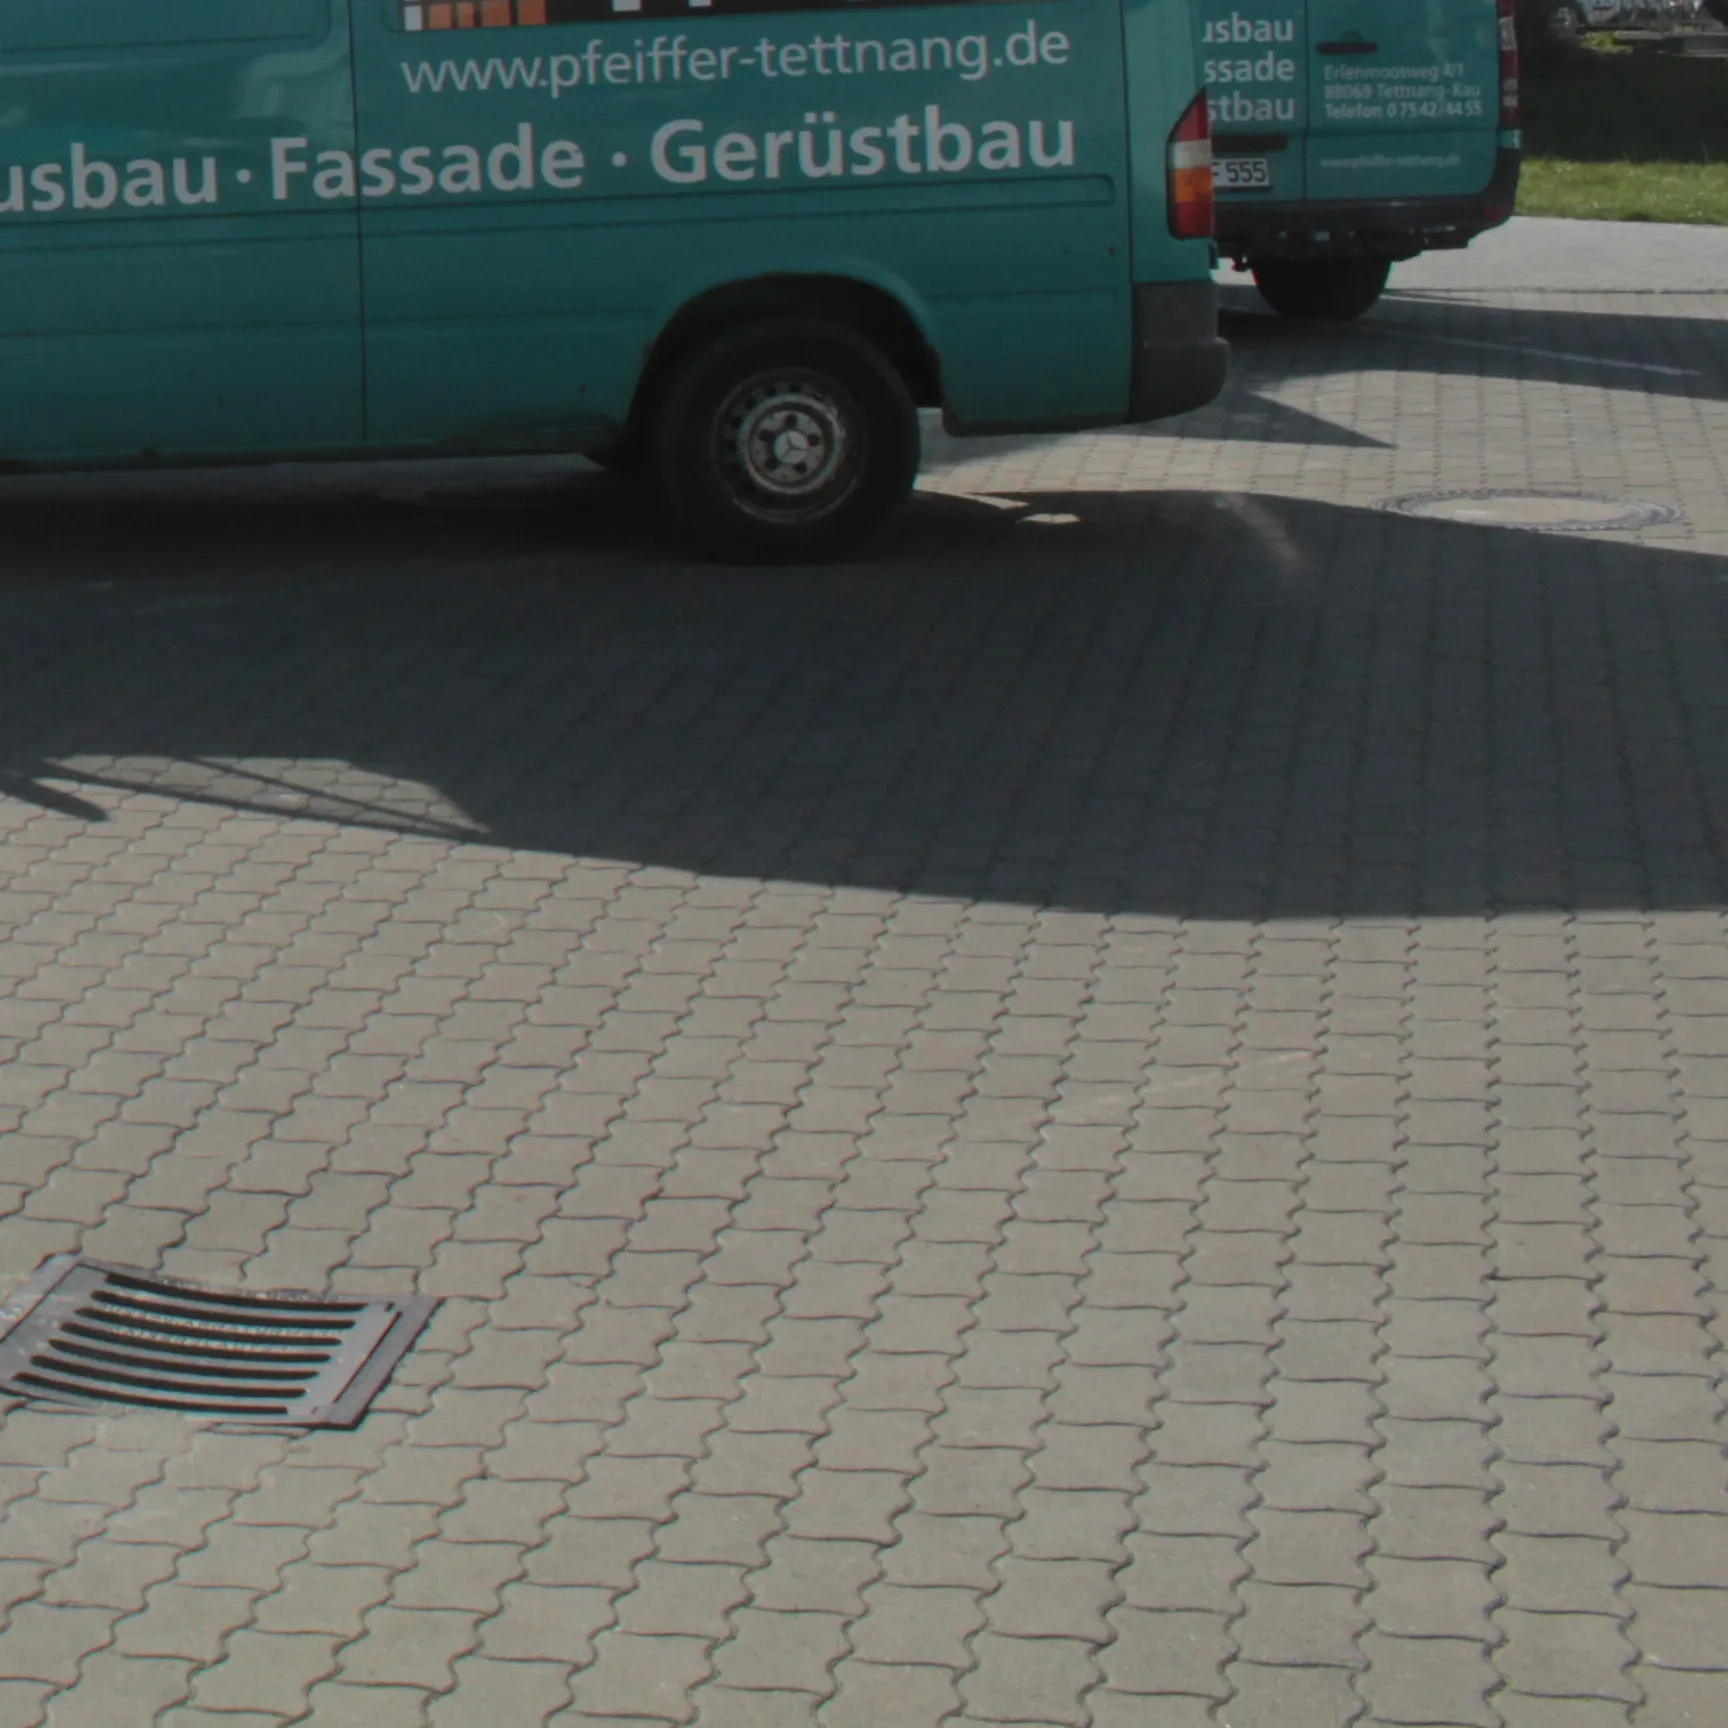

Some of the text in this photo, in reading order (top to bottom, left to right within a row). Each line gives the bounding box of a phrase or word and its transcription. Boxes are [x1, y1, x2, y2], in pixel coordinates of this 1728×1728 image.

[401, 19, 1071, 98] www.pfeiffer-tettnang.de
[1324, 102, 1383, 119] Telefon
[269, 122, 585, 200] Fassade
[650, 105, 1075, 183] Gerüstbau
[1225, 160, 1266, 183] 555
